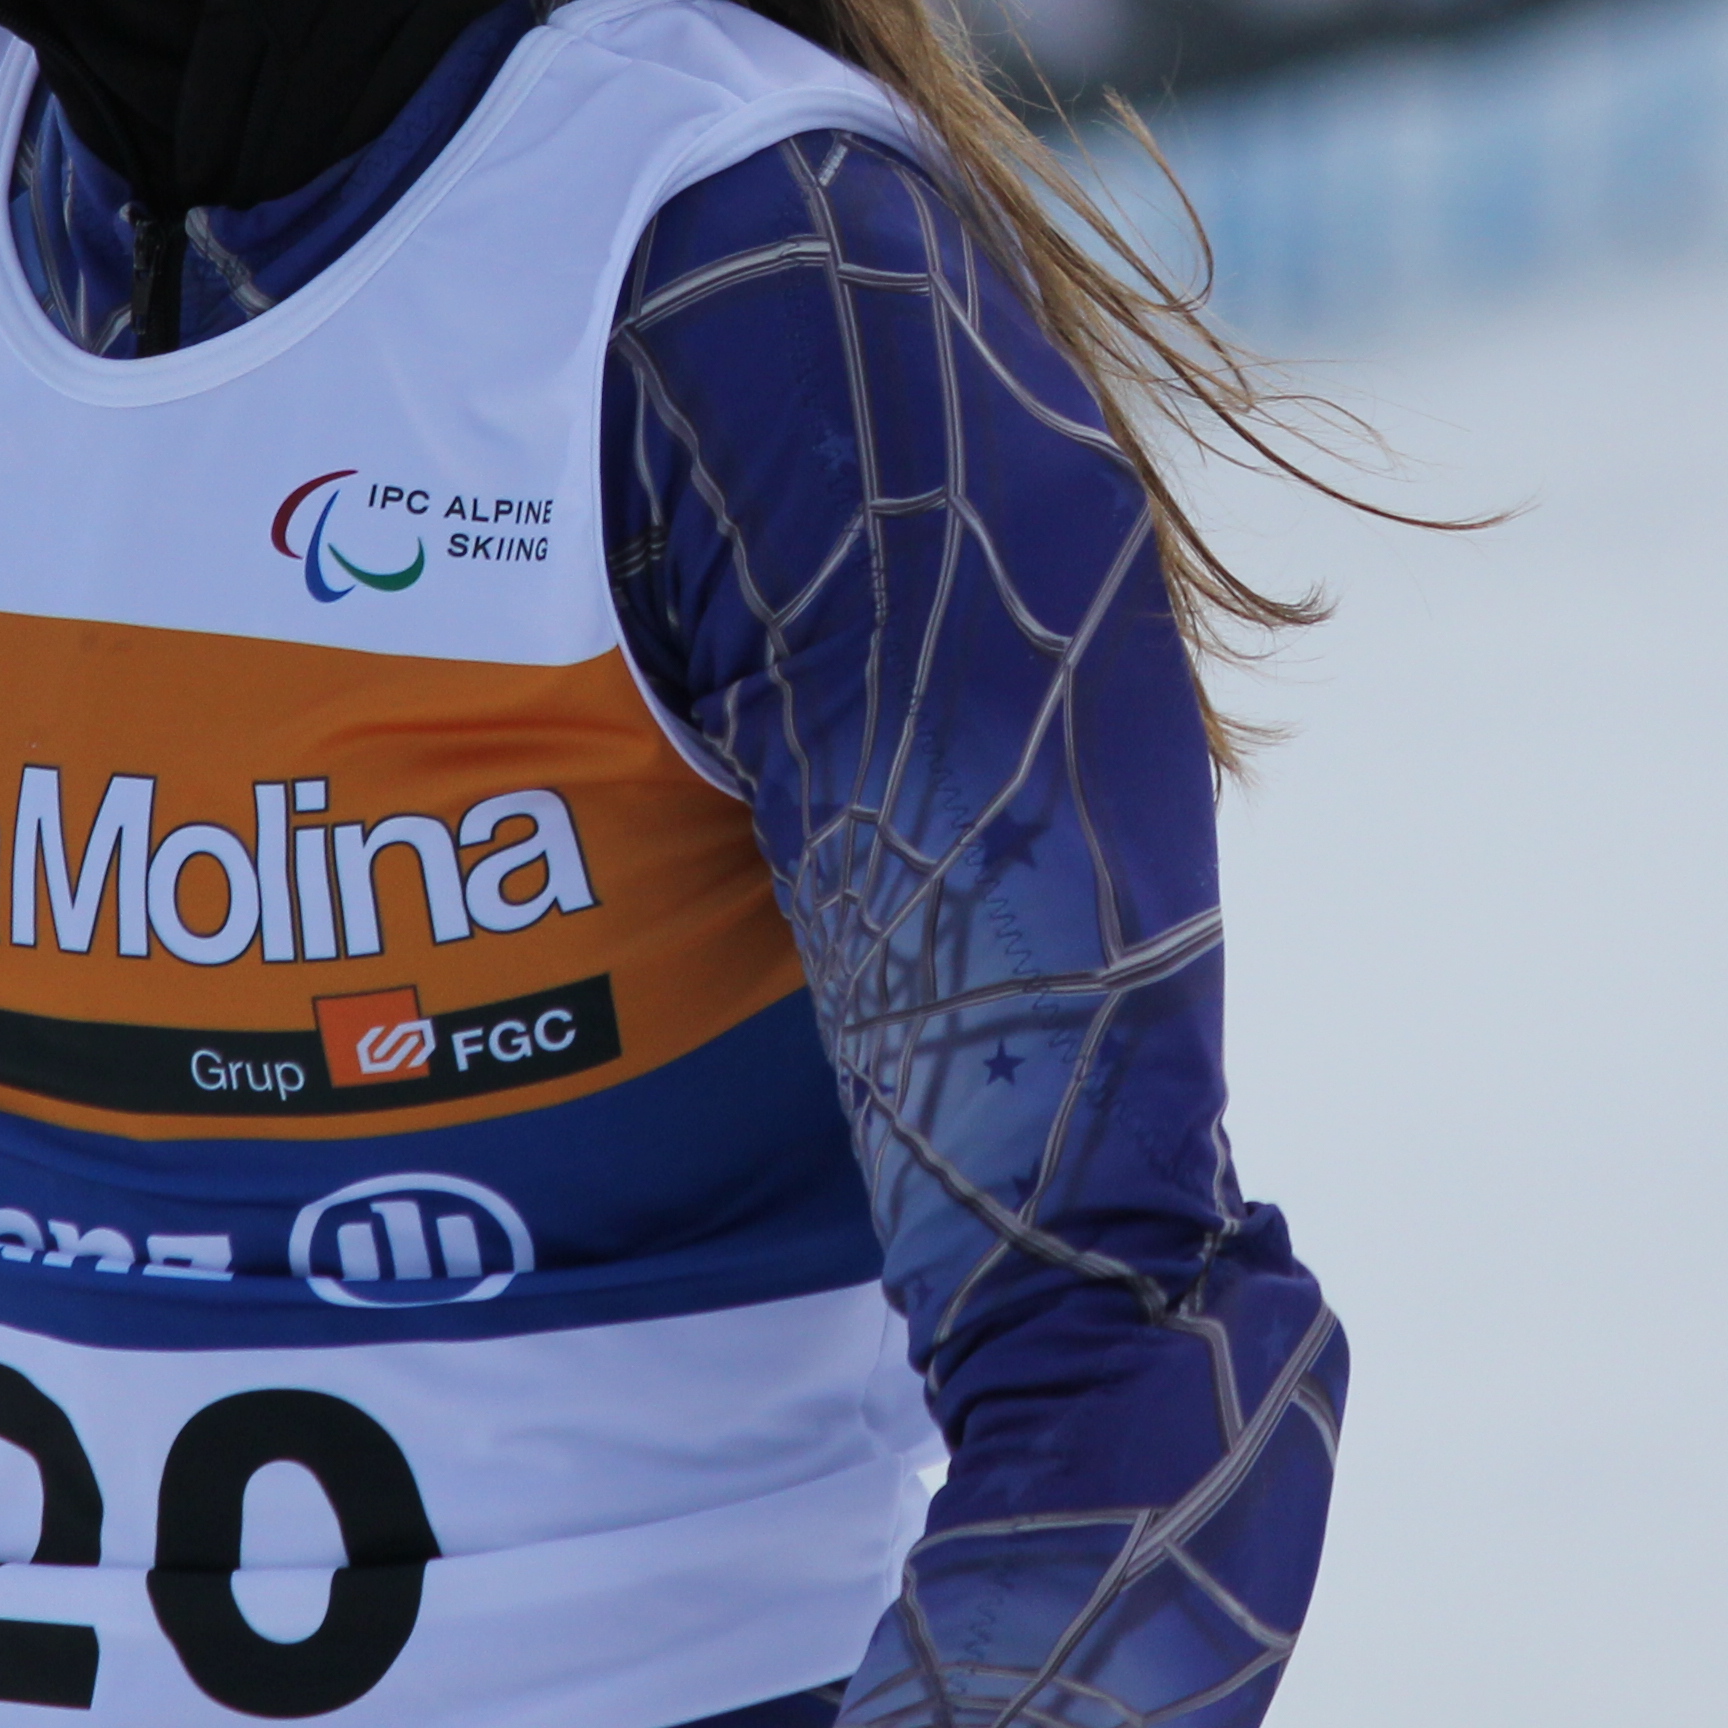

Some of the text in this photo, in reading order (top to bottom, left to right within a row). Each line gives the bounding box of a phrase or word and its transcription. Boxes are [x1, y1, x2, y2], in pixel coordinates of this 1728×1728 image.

[368, 484, 553, 524] IPC ALPINE
[447, 532, 549, 562] SKIING
[190, 1009, 576, 1102] Grup FGC
